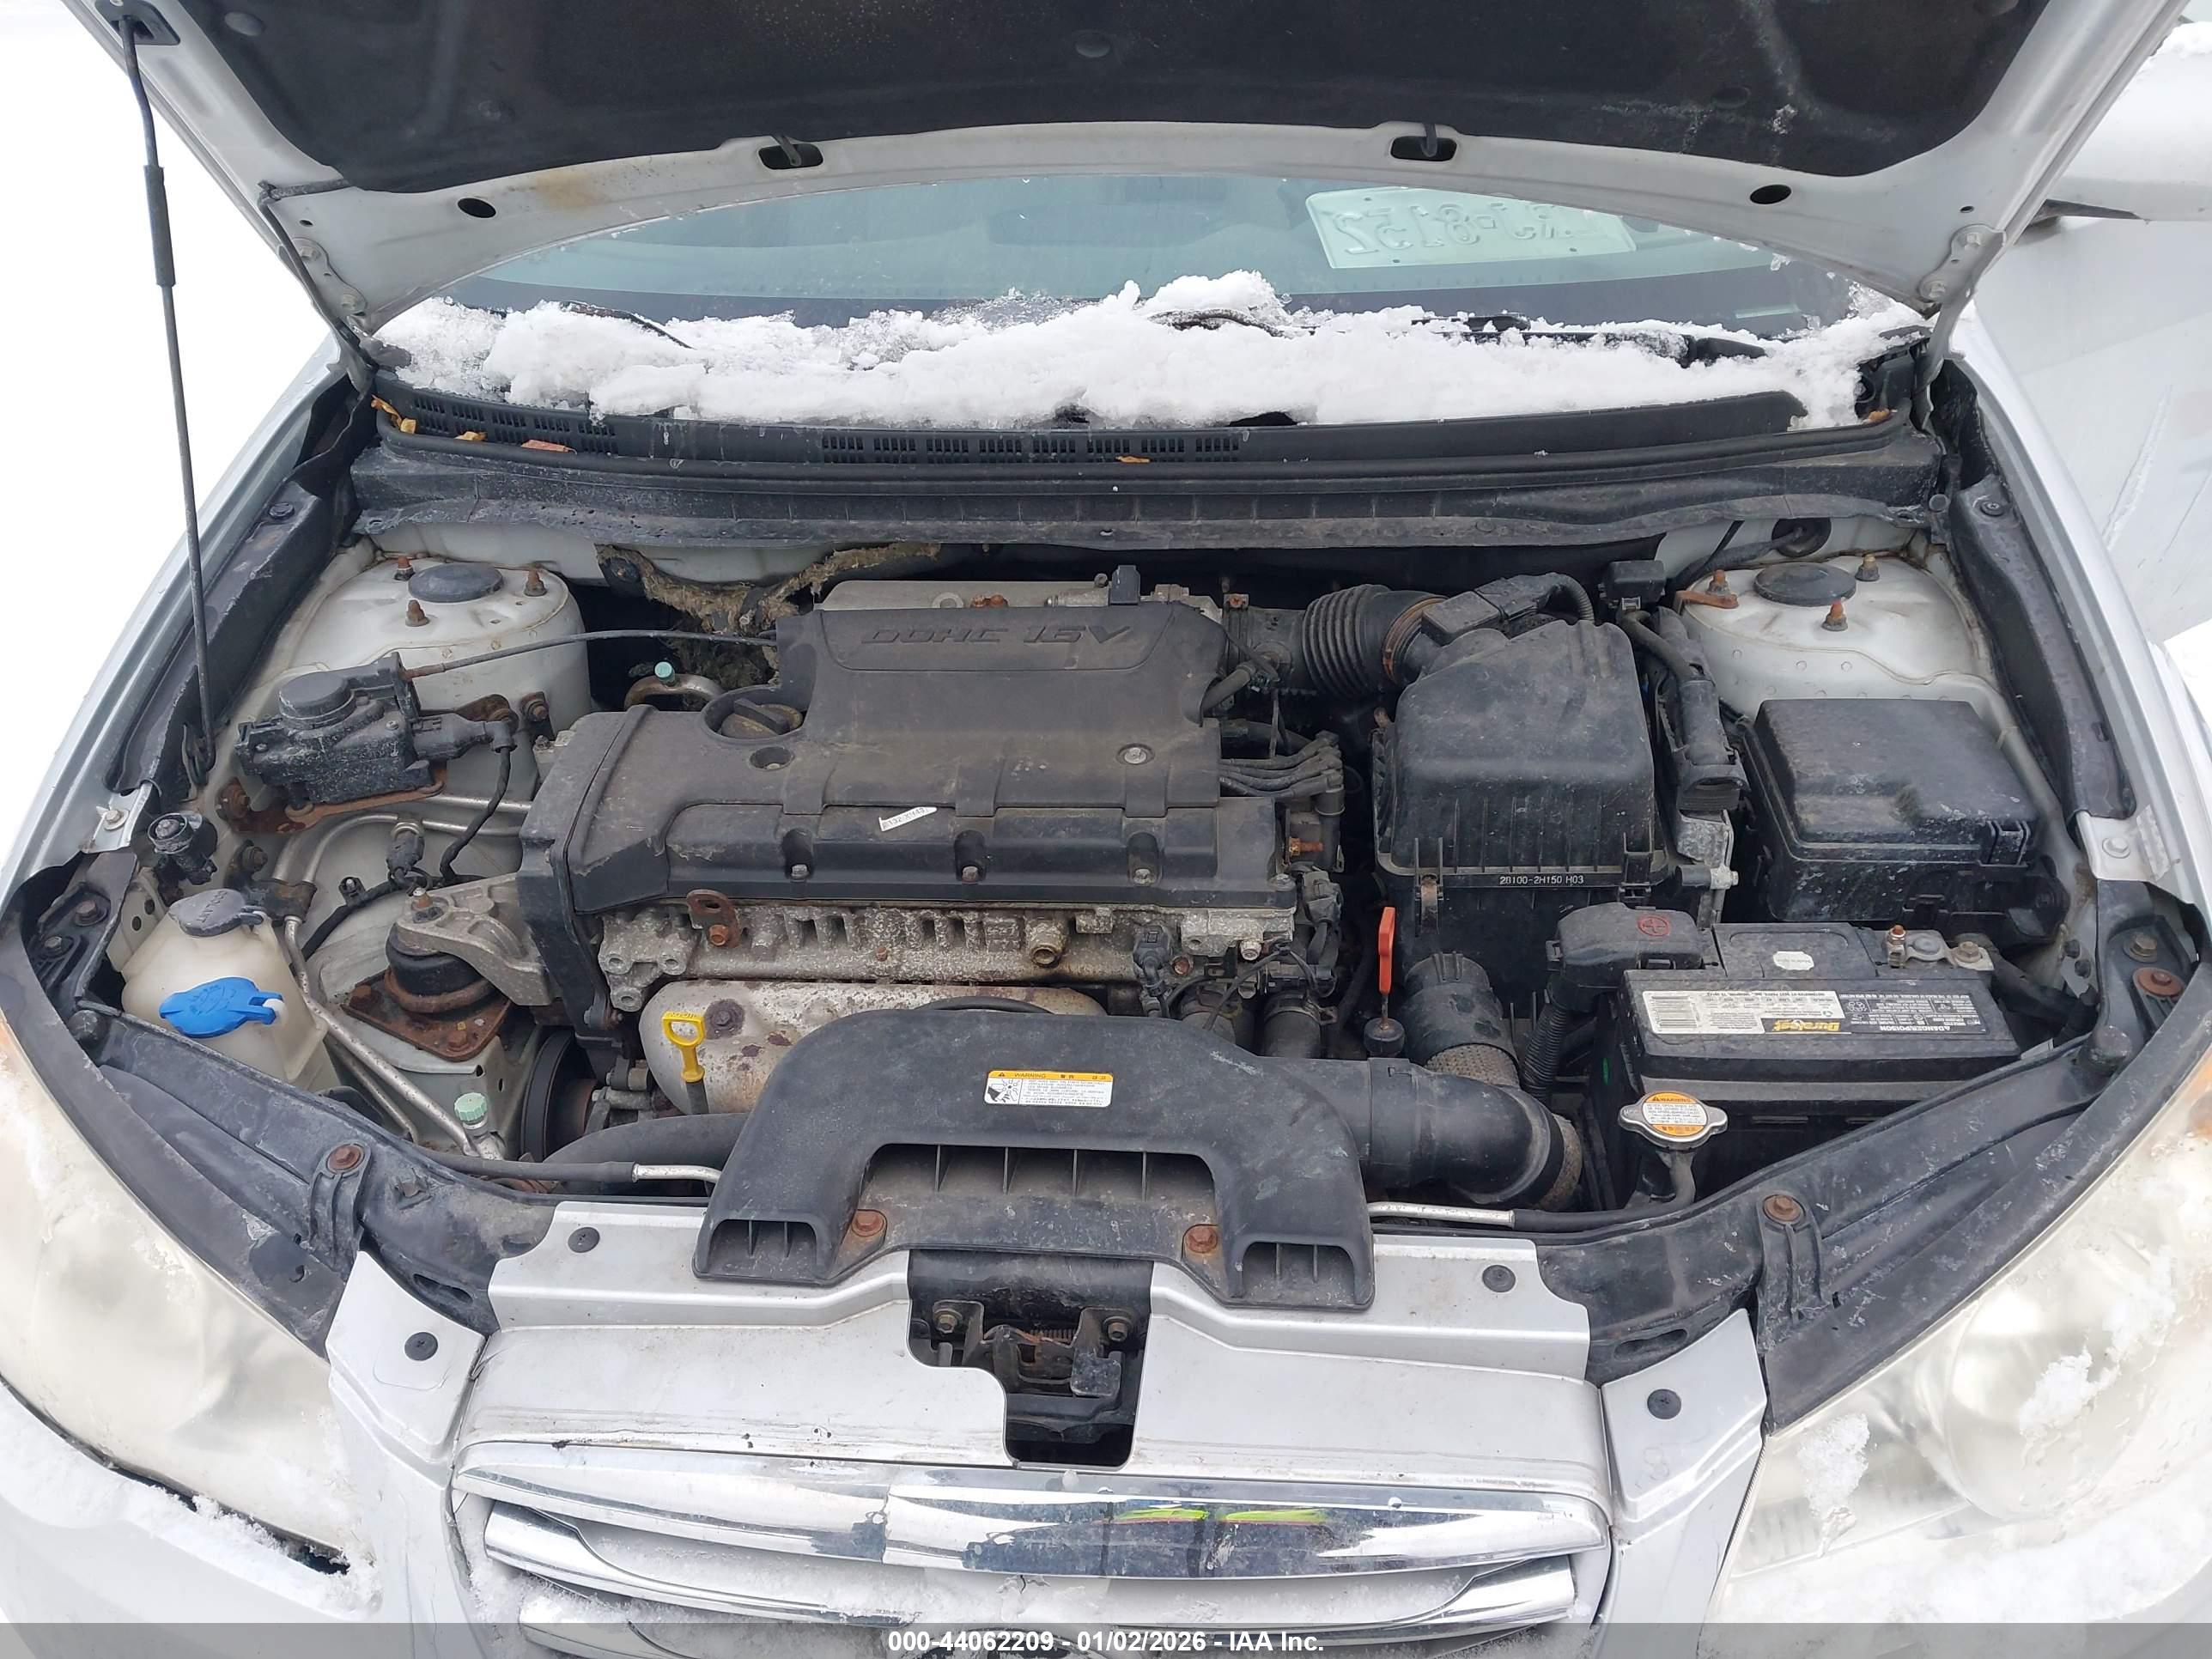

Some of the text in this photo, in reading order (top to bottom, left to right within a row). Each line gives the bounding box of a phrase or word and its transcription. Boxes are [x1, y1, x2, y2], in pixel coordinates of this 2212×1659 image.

[860, 625, 1131, 644] DOHC 16V
[1565, 875, 1584, 884] H03
